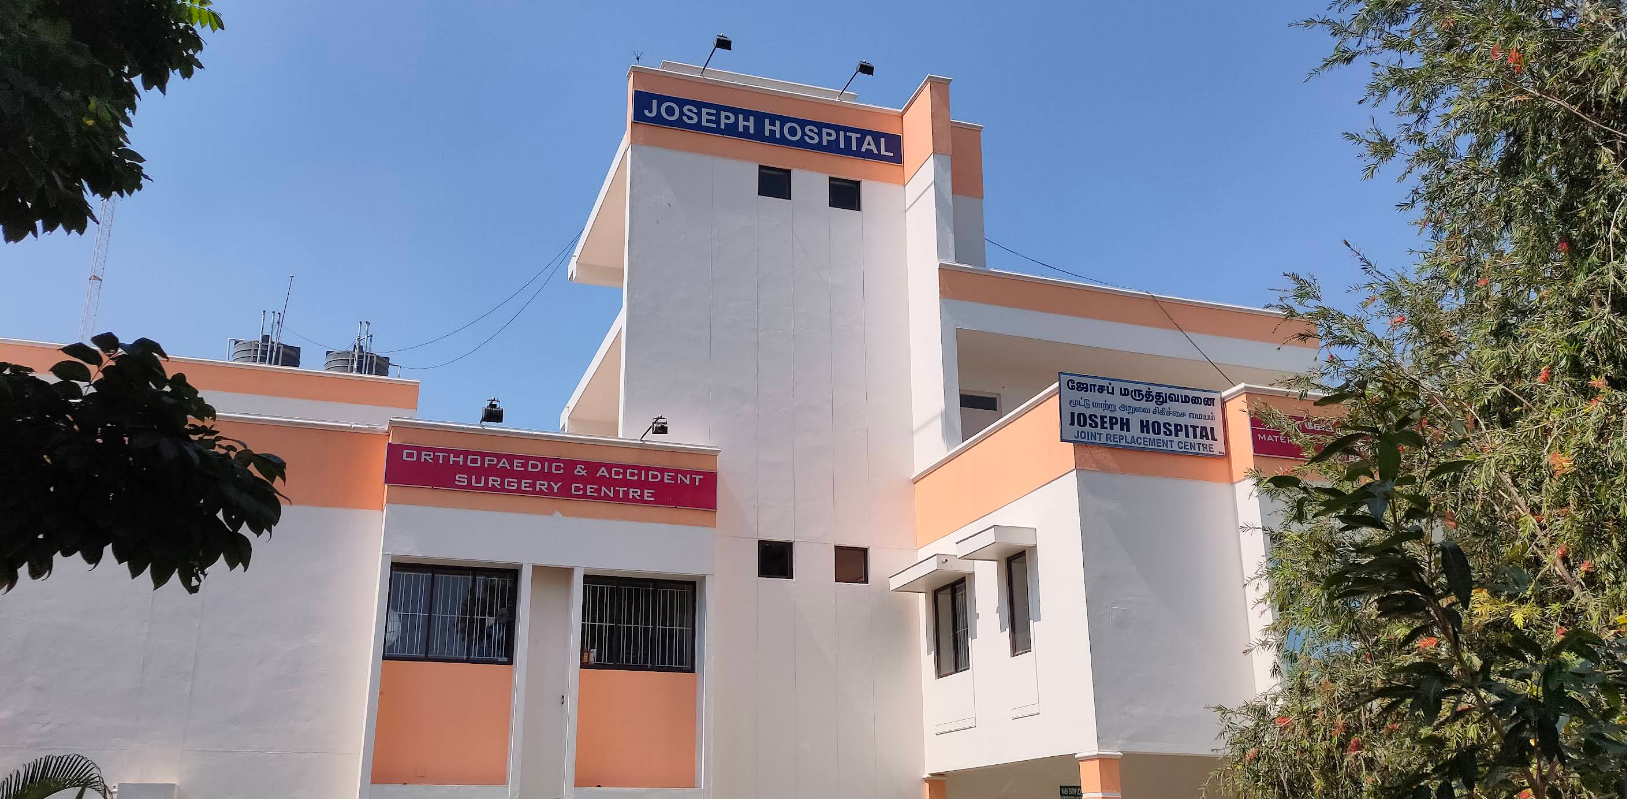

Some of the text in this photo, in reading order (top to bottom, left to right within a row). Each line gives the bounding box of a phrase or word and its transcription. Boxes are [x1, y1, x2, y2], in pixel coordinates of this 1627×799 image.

[644, 99, 894, 157] JOSEPH HOSPITAL
[1066, 379, 1216, 407] ஜோசப் மருத்துவமனை
[1092, 400, 1117, 413] மாற்று
[1119, 404, 1151, 415] அறுவை
[1152, 406, 1187, 418] சிகிச்சை
[1069, 411, 1218, 442] JOSEPH HOSPITAL
[1074, 430, 1215, 453] JOINT REPLACEMENT CENTRE
[402, 449, 704, 486] ORTHOPAEDIC & ACCIDENT
[454, 474, 655, 501] SURGERY CENTRE
